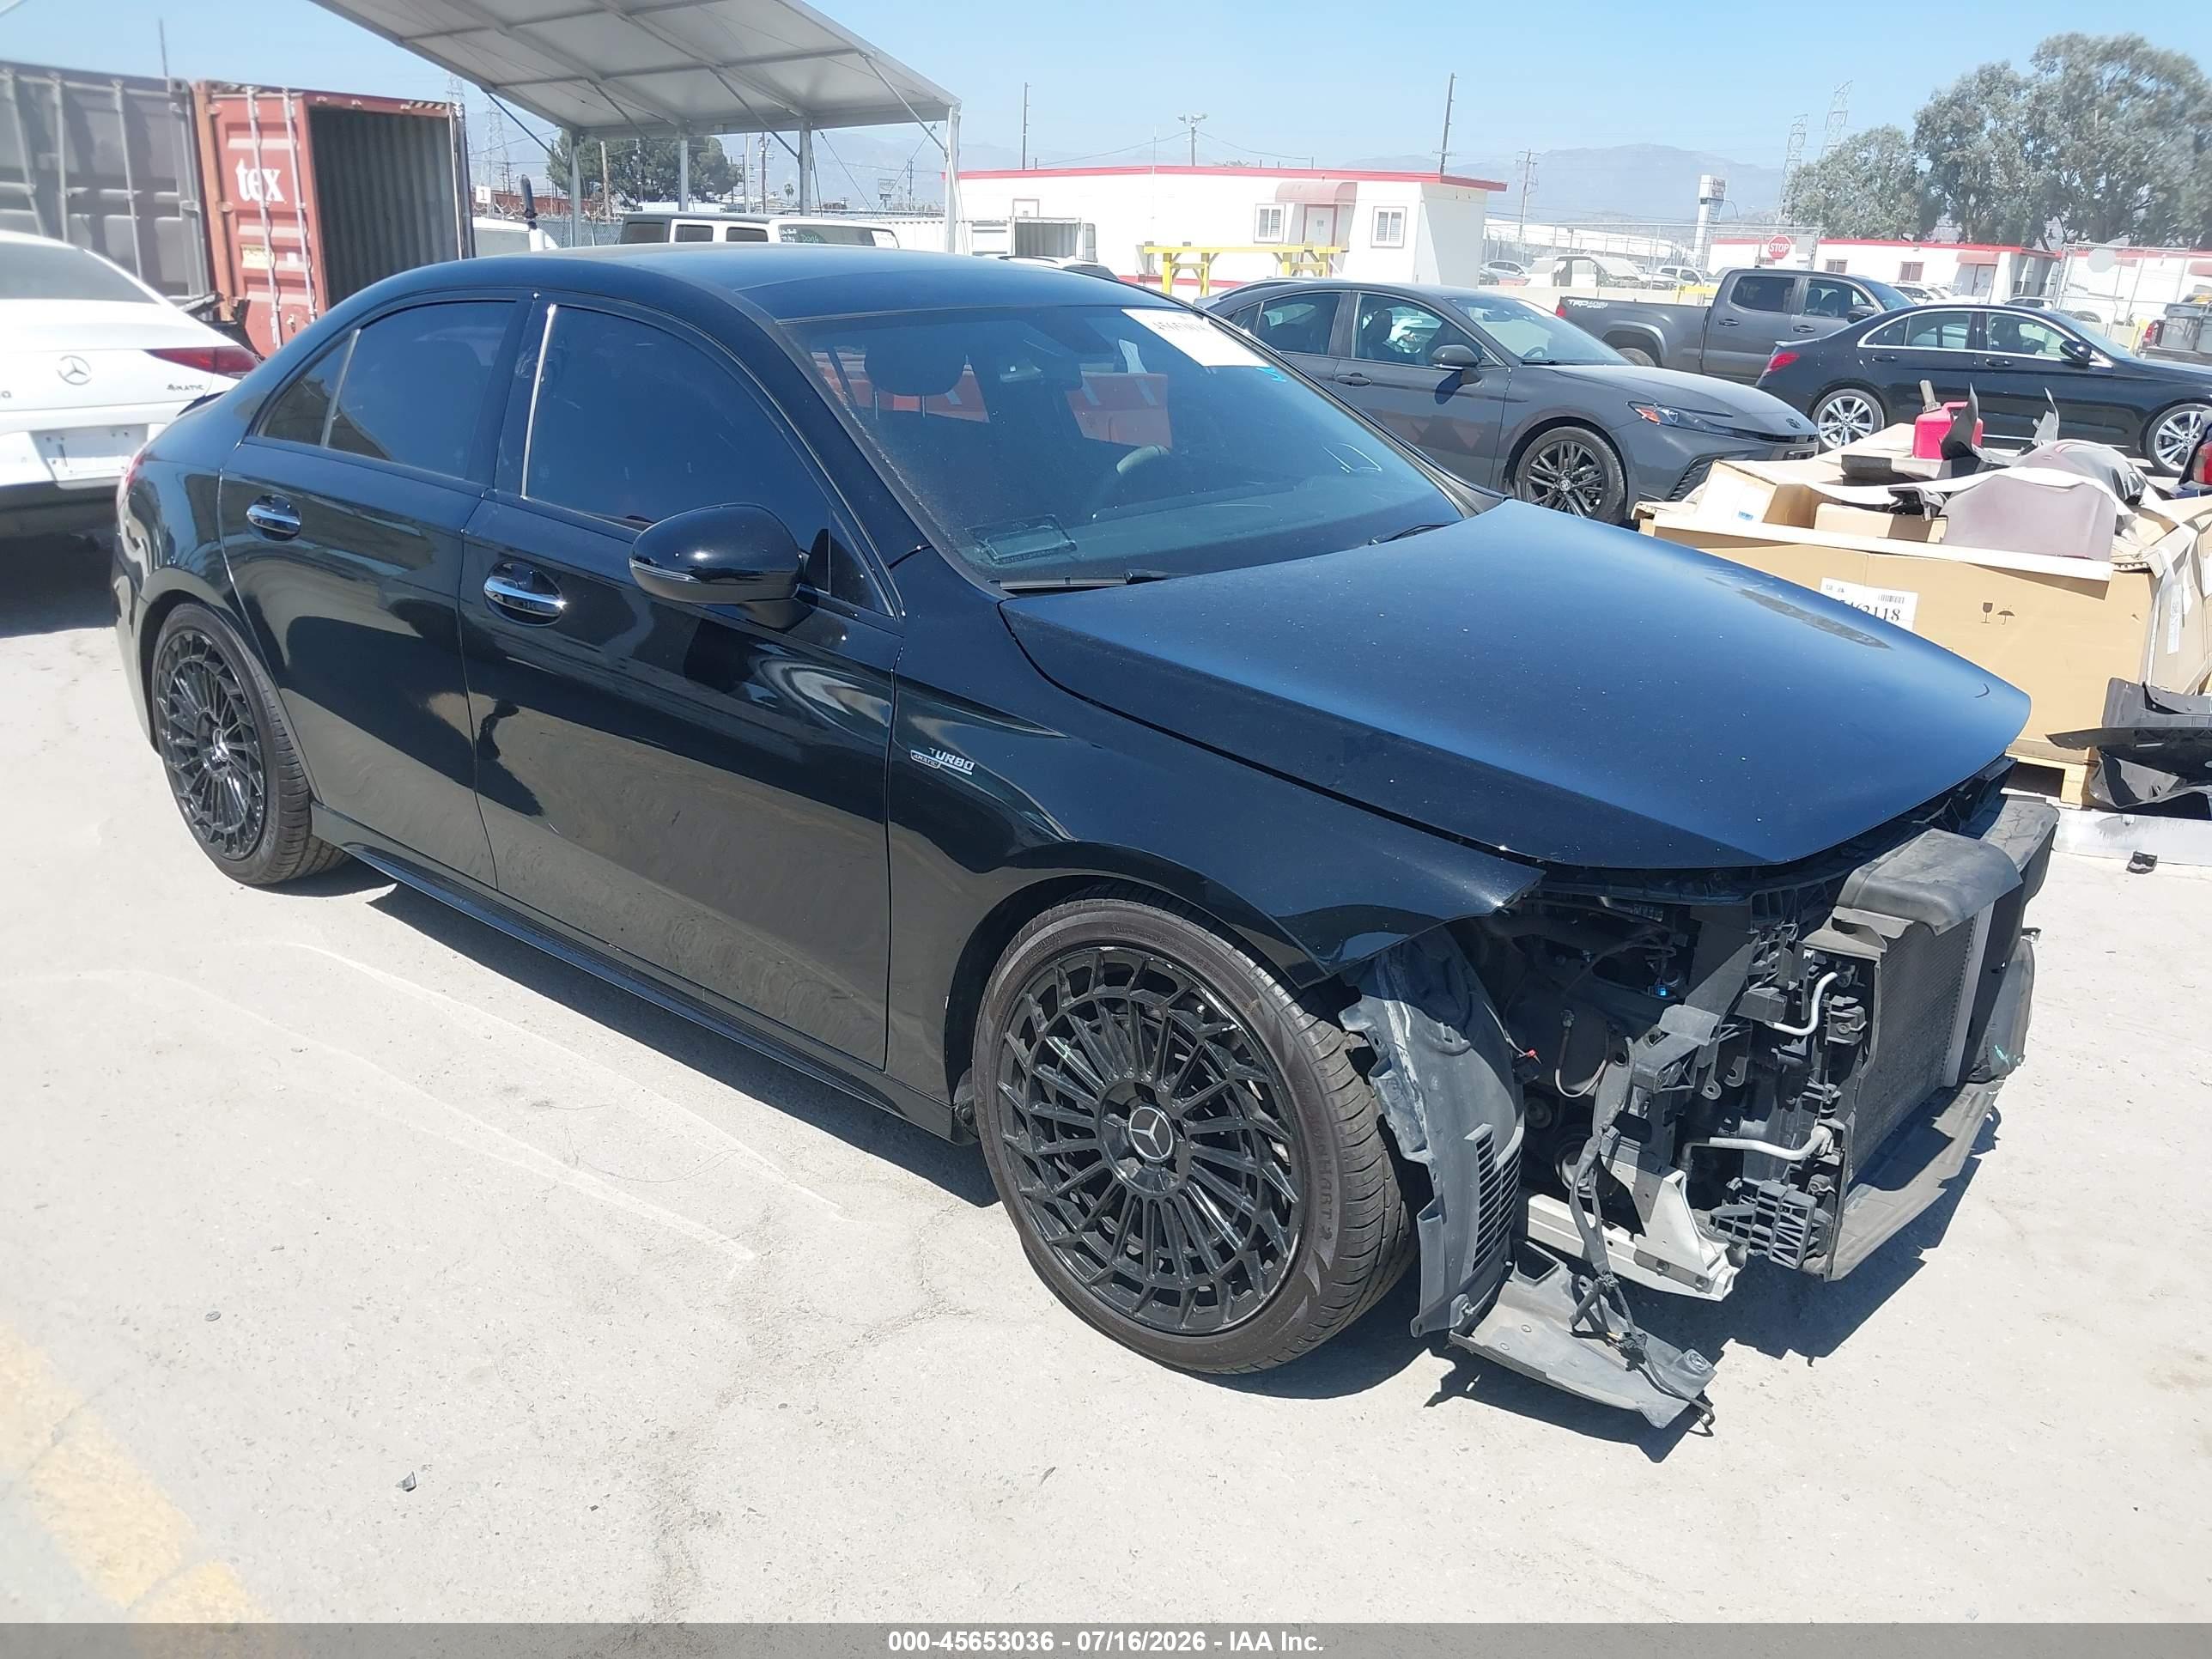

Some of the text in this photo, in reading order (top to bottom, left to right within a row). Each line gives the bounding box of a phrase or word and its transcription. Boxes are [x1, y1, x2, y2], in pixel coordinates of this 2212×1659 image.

[235, 158, 285, 202] tex
[480, 189, 487, 201] 1
[1769, 243, 1790, 254] STOP
[928, 746, 975, 771] TURBO
